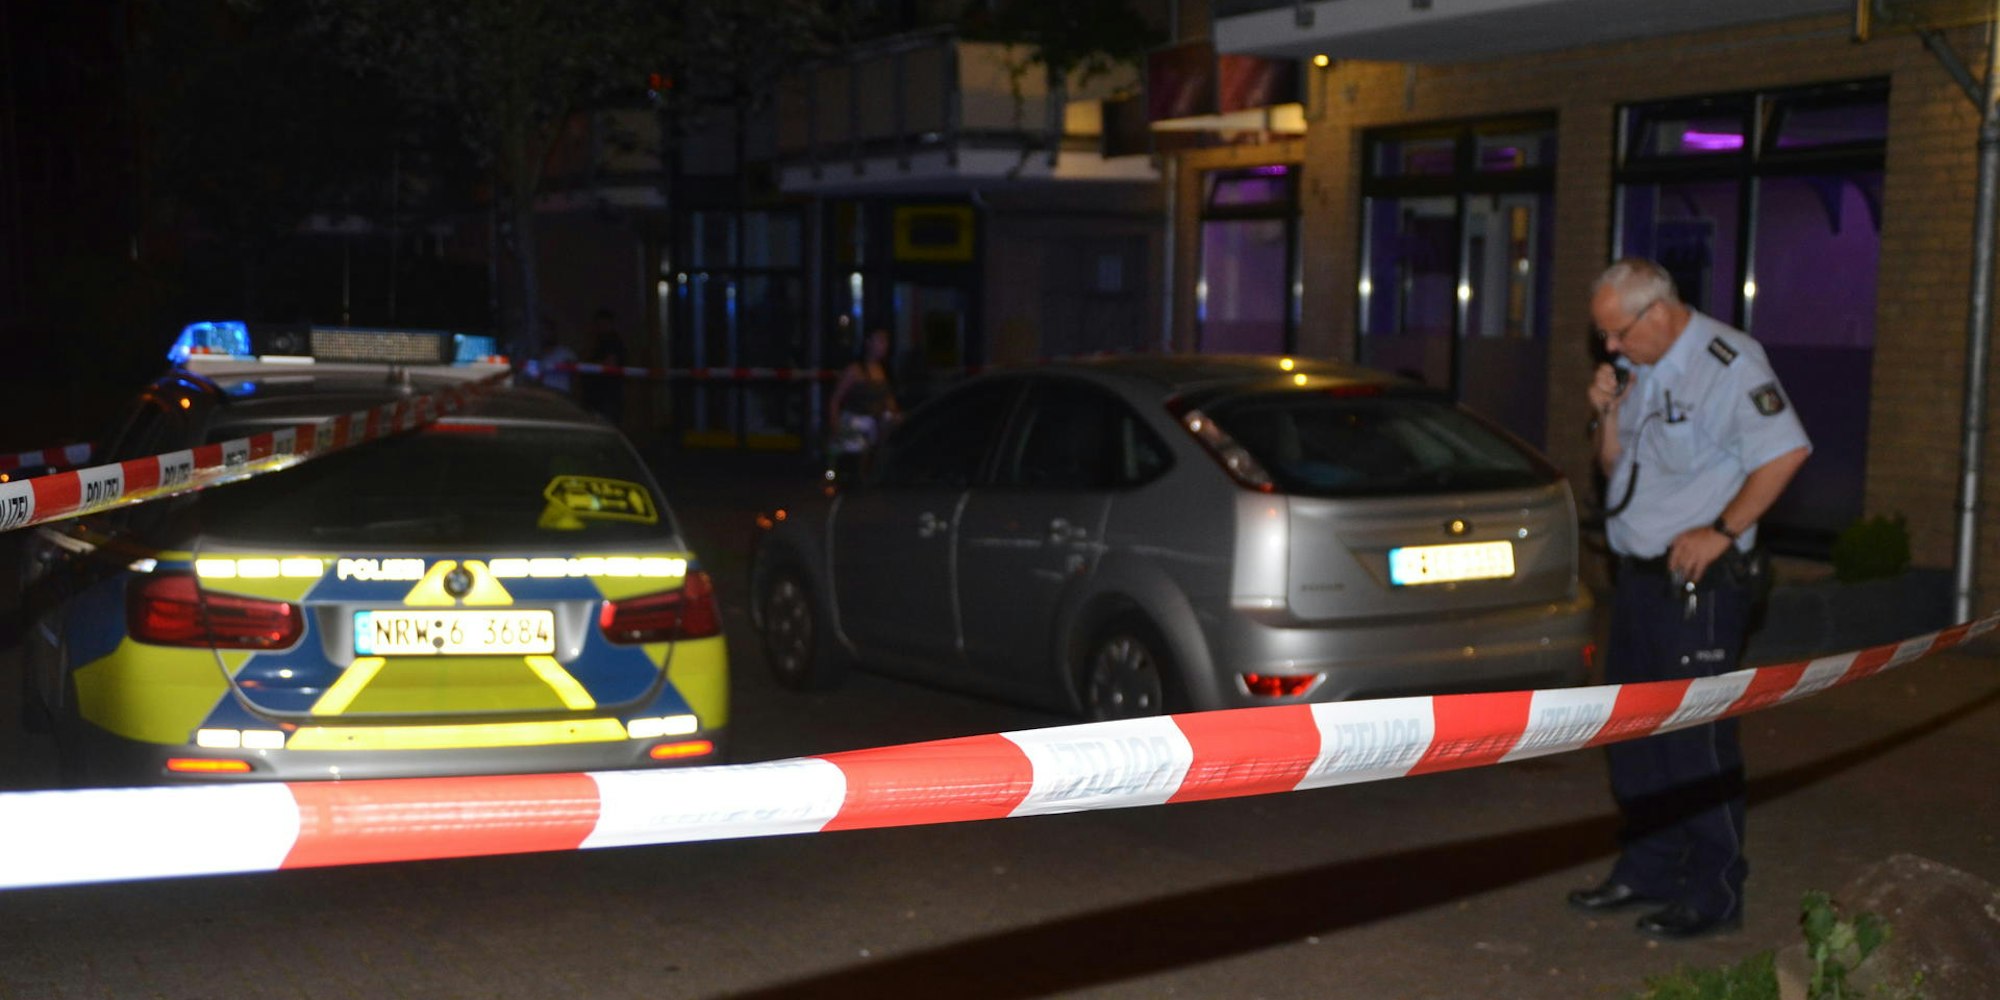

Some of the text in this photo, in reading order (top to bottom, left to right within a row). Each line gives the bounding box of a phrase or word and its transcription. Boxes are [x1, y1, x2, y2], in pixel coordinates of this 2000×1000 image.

[85, 478, 120, 506] POLIZEI
[375, 618, 549, 646] NRW 6 3684
